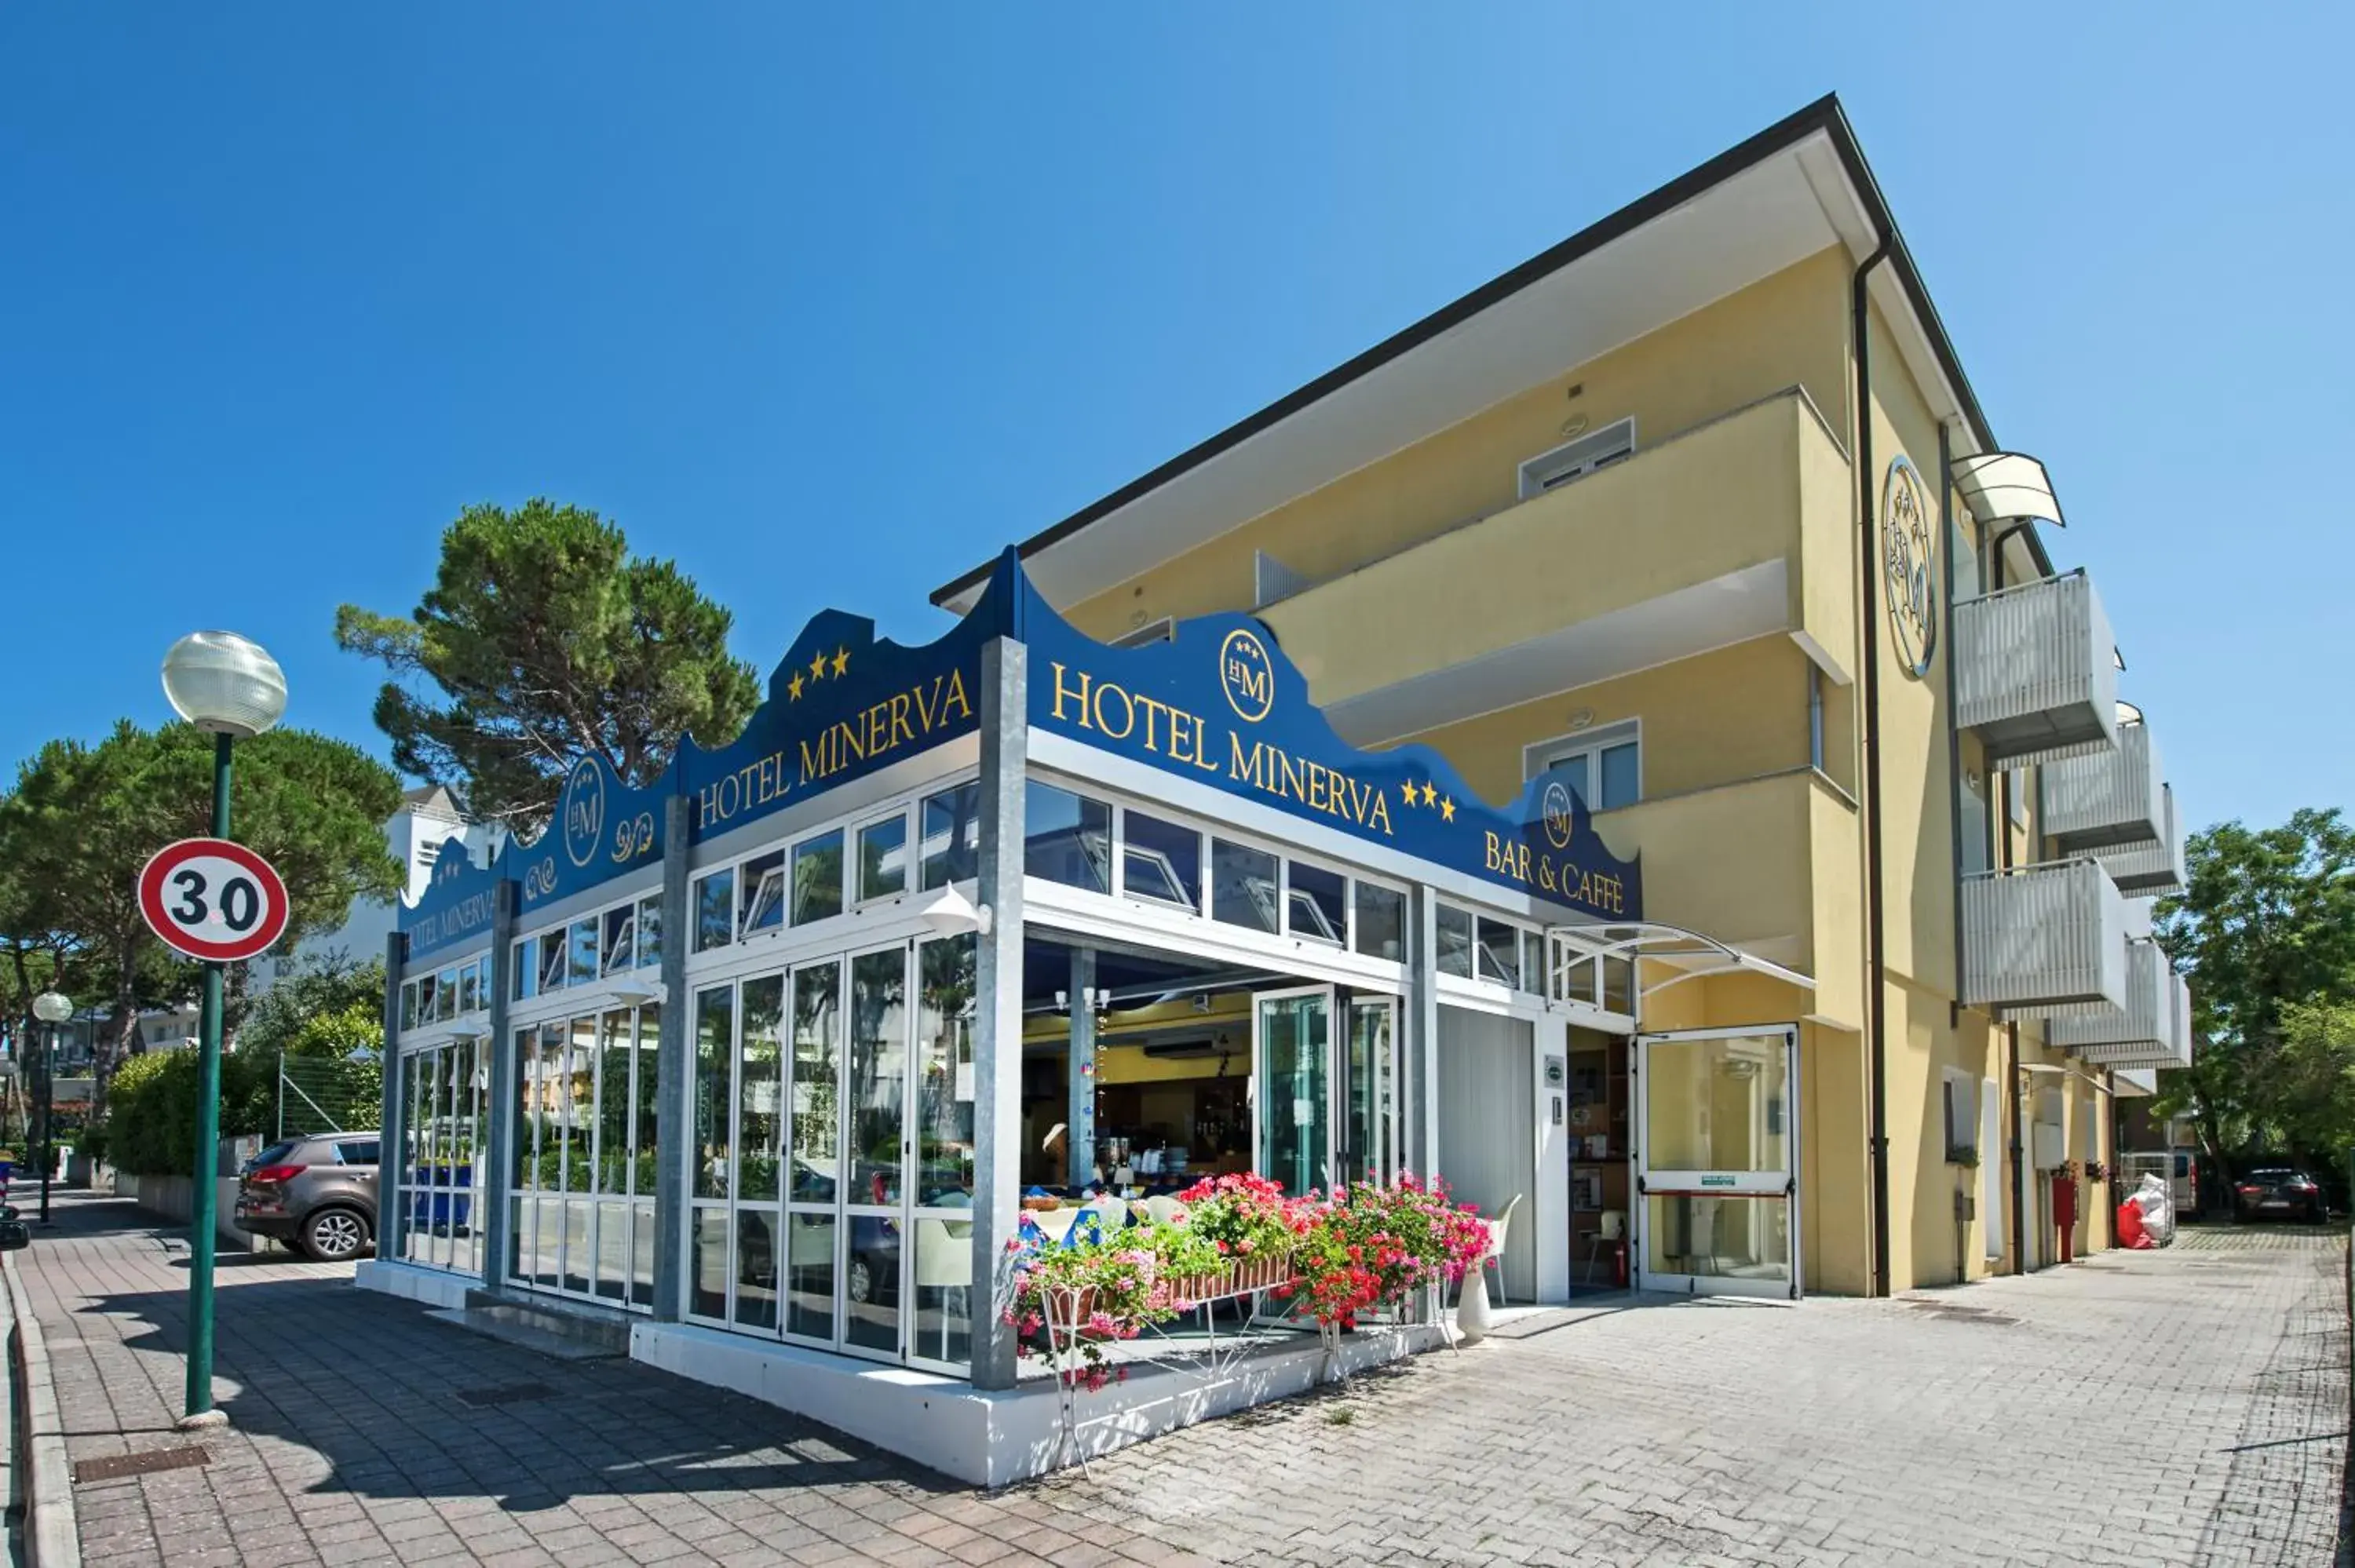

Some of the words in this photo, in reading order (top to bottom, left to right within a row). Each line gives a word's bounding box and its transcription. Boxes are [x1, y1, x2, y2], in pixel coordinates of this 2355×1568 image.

[699, 751, 790, 830] HOTEL
[799, 667, 973, 787] MINERVA
[1050, 662, 1218, 771] HOTEL
[1229, 730, 1393, 836] MINERVA
[171, 869, 260, 932] 30
[1484, 830, 1534, 885] BAR
[1539, 853, 1558, 892] &
[1562, 863, 1624, 915] CAFFÈ
